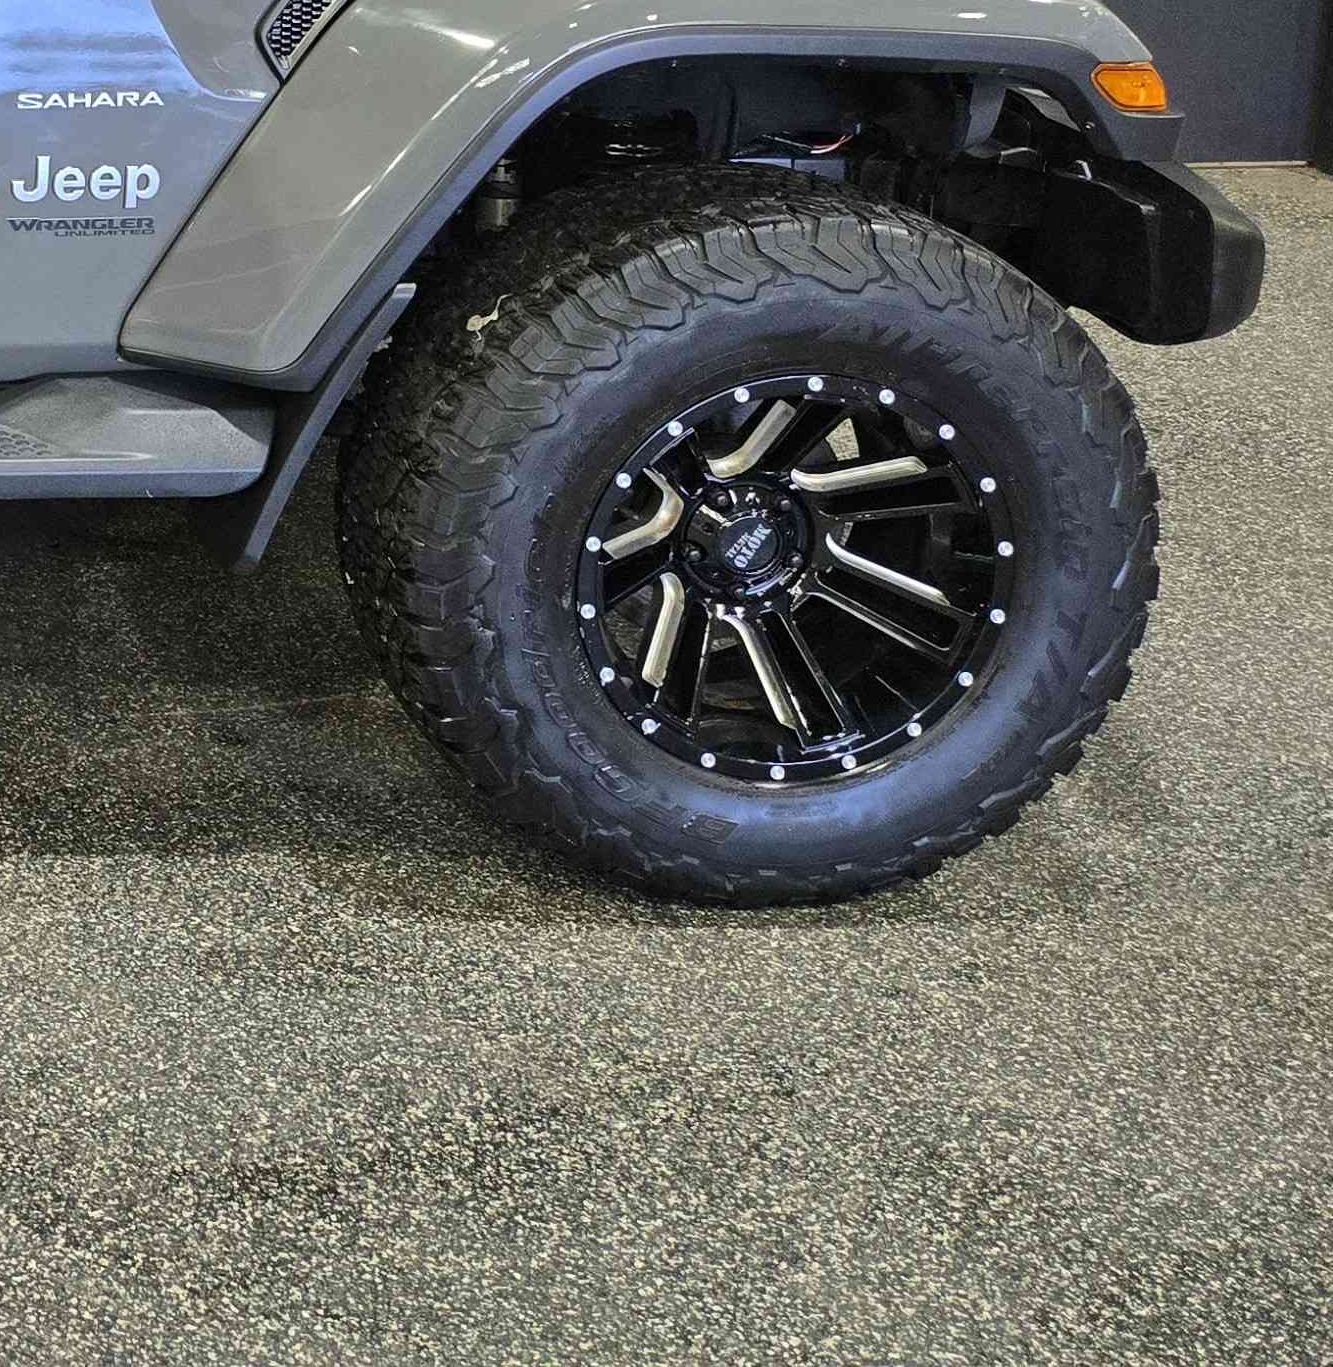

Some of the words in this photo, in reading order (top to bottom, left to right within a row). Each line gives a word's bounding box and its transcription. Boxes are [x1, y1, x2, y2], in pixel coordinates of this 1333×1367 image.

[17, 90, 164, 109] SAHARA
[11, 155, 161, 209] Jeep
[8, 218, 155, 232] WRANGLER
[54, 229, 156, 238] UNLIMITED
[734, 523, 774, 568] MOTO
